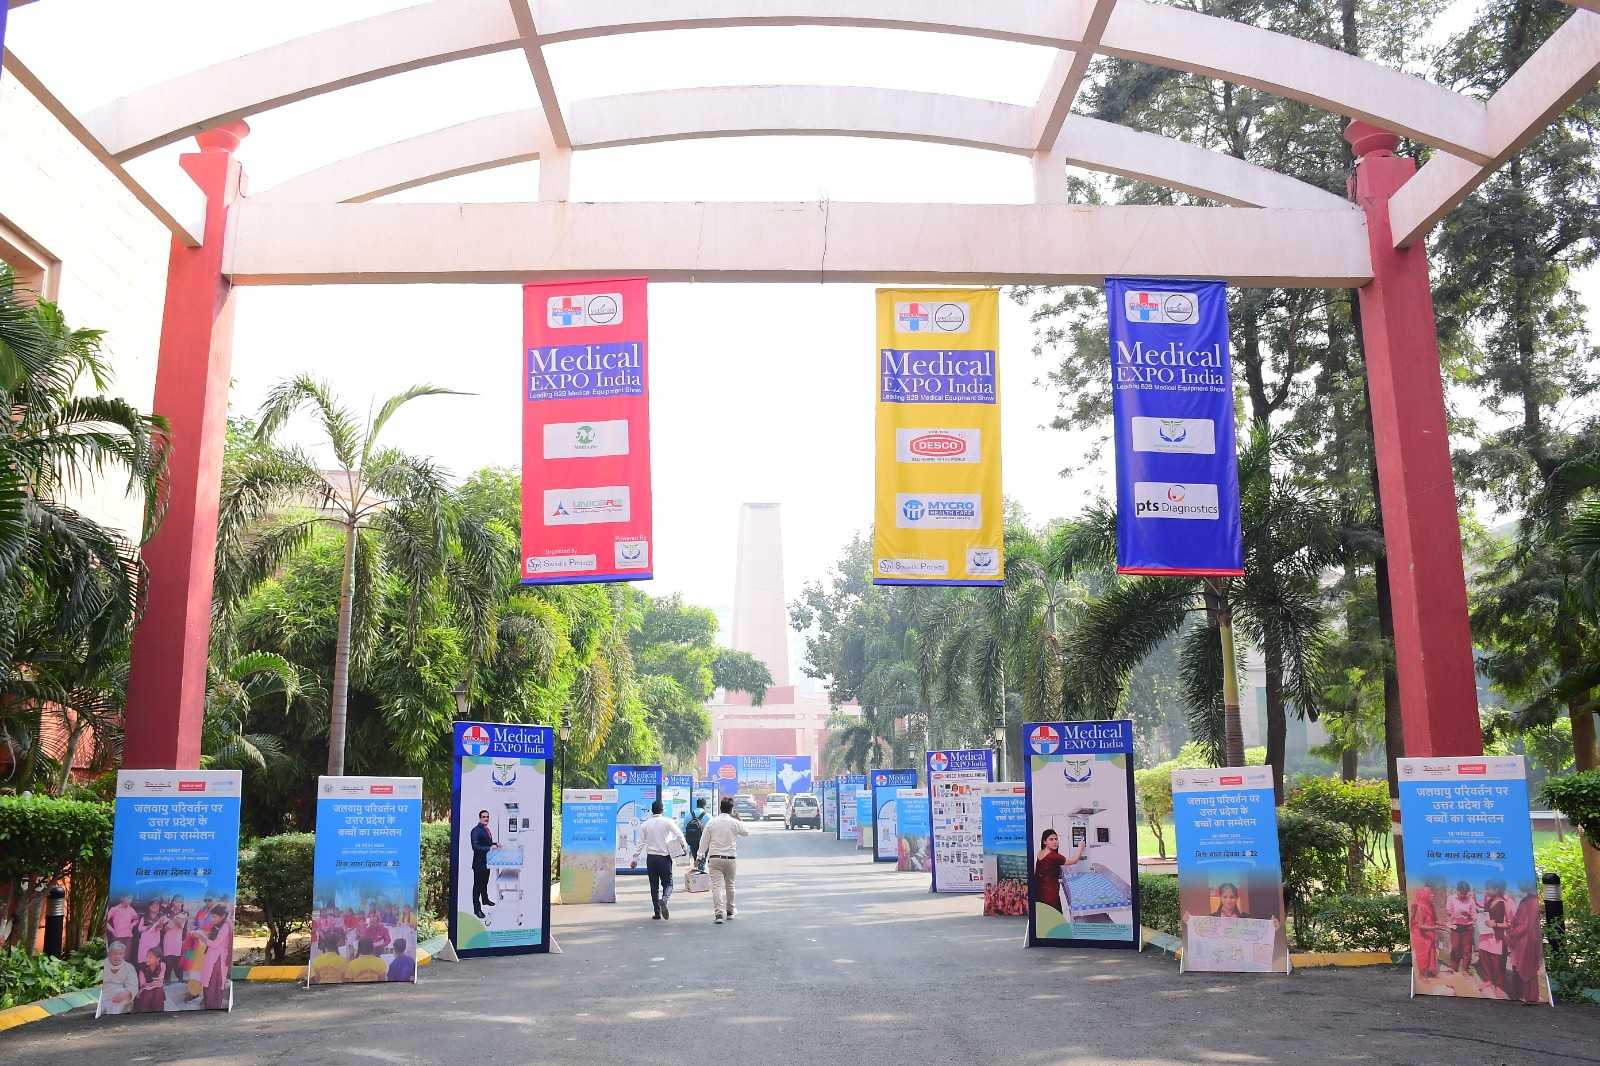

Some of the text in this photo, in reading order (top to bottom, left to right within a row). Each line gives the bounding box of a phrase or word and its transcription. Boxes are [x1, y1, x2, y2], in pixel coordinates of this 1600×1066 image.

[530, 343, 640, 374] Medical
[1116, 341, 1222, 367] Medical
[883, 351, 992, 376] Medical
[530, 370, 641, 391] EXPO India
[1117, 367, 1224, 384] EXPO India
[884, 377, 993, 394] EXPO India
[1178, 385, 1209, 393] Equipment
[918, 441, 958, 450] DESCO
[928, 501, 974, 509] MYCRO
[1136, 500, 1218, 515] pts Diagnostics
[494, 727, 544, 744] Medical
[1064, 724, 1122, 739] Medical
[494, 743, 544, 753] EXPO India
[1064, 740, 1096, 749] EXPO
[1100, 739, 1123, 748] India
[951, 752, 985, 761] Medical
[1416, 784, 1509, 798] जलवायु परिवर्तन पर
[133, 801, 224, 815] जलवायु परिवर्तन पर
[1432, 799, 1494, 810] उत्तर प्रदेश के
[148, 815, 208, 827] उत्तर प्रदेश के
[1425, 812, 1504, 823] बच्चों का सम्मेलन
[139, 829, 215, 840] बच्चों का सम्मेलन
